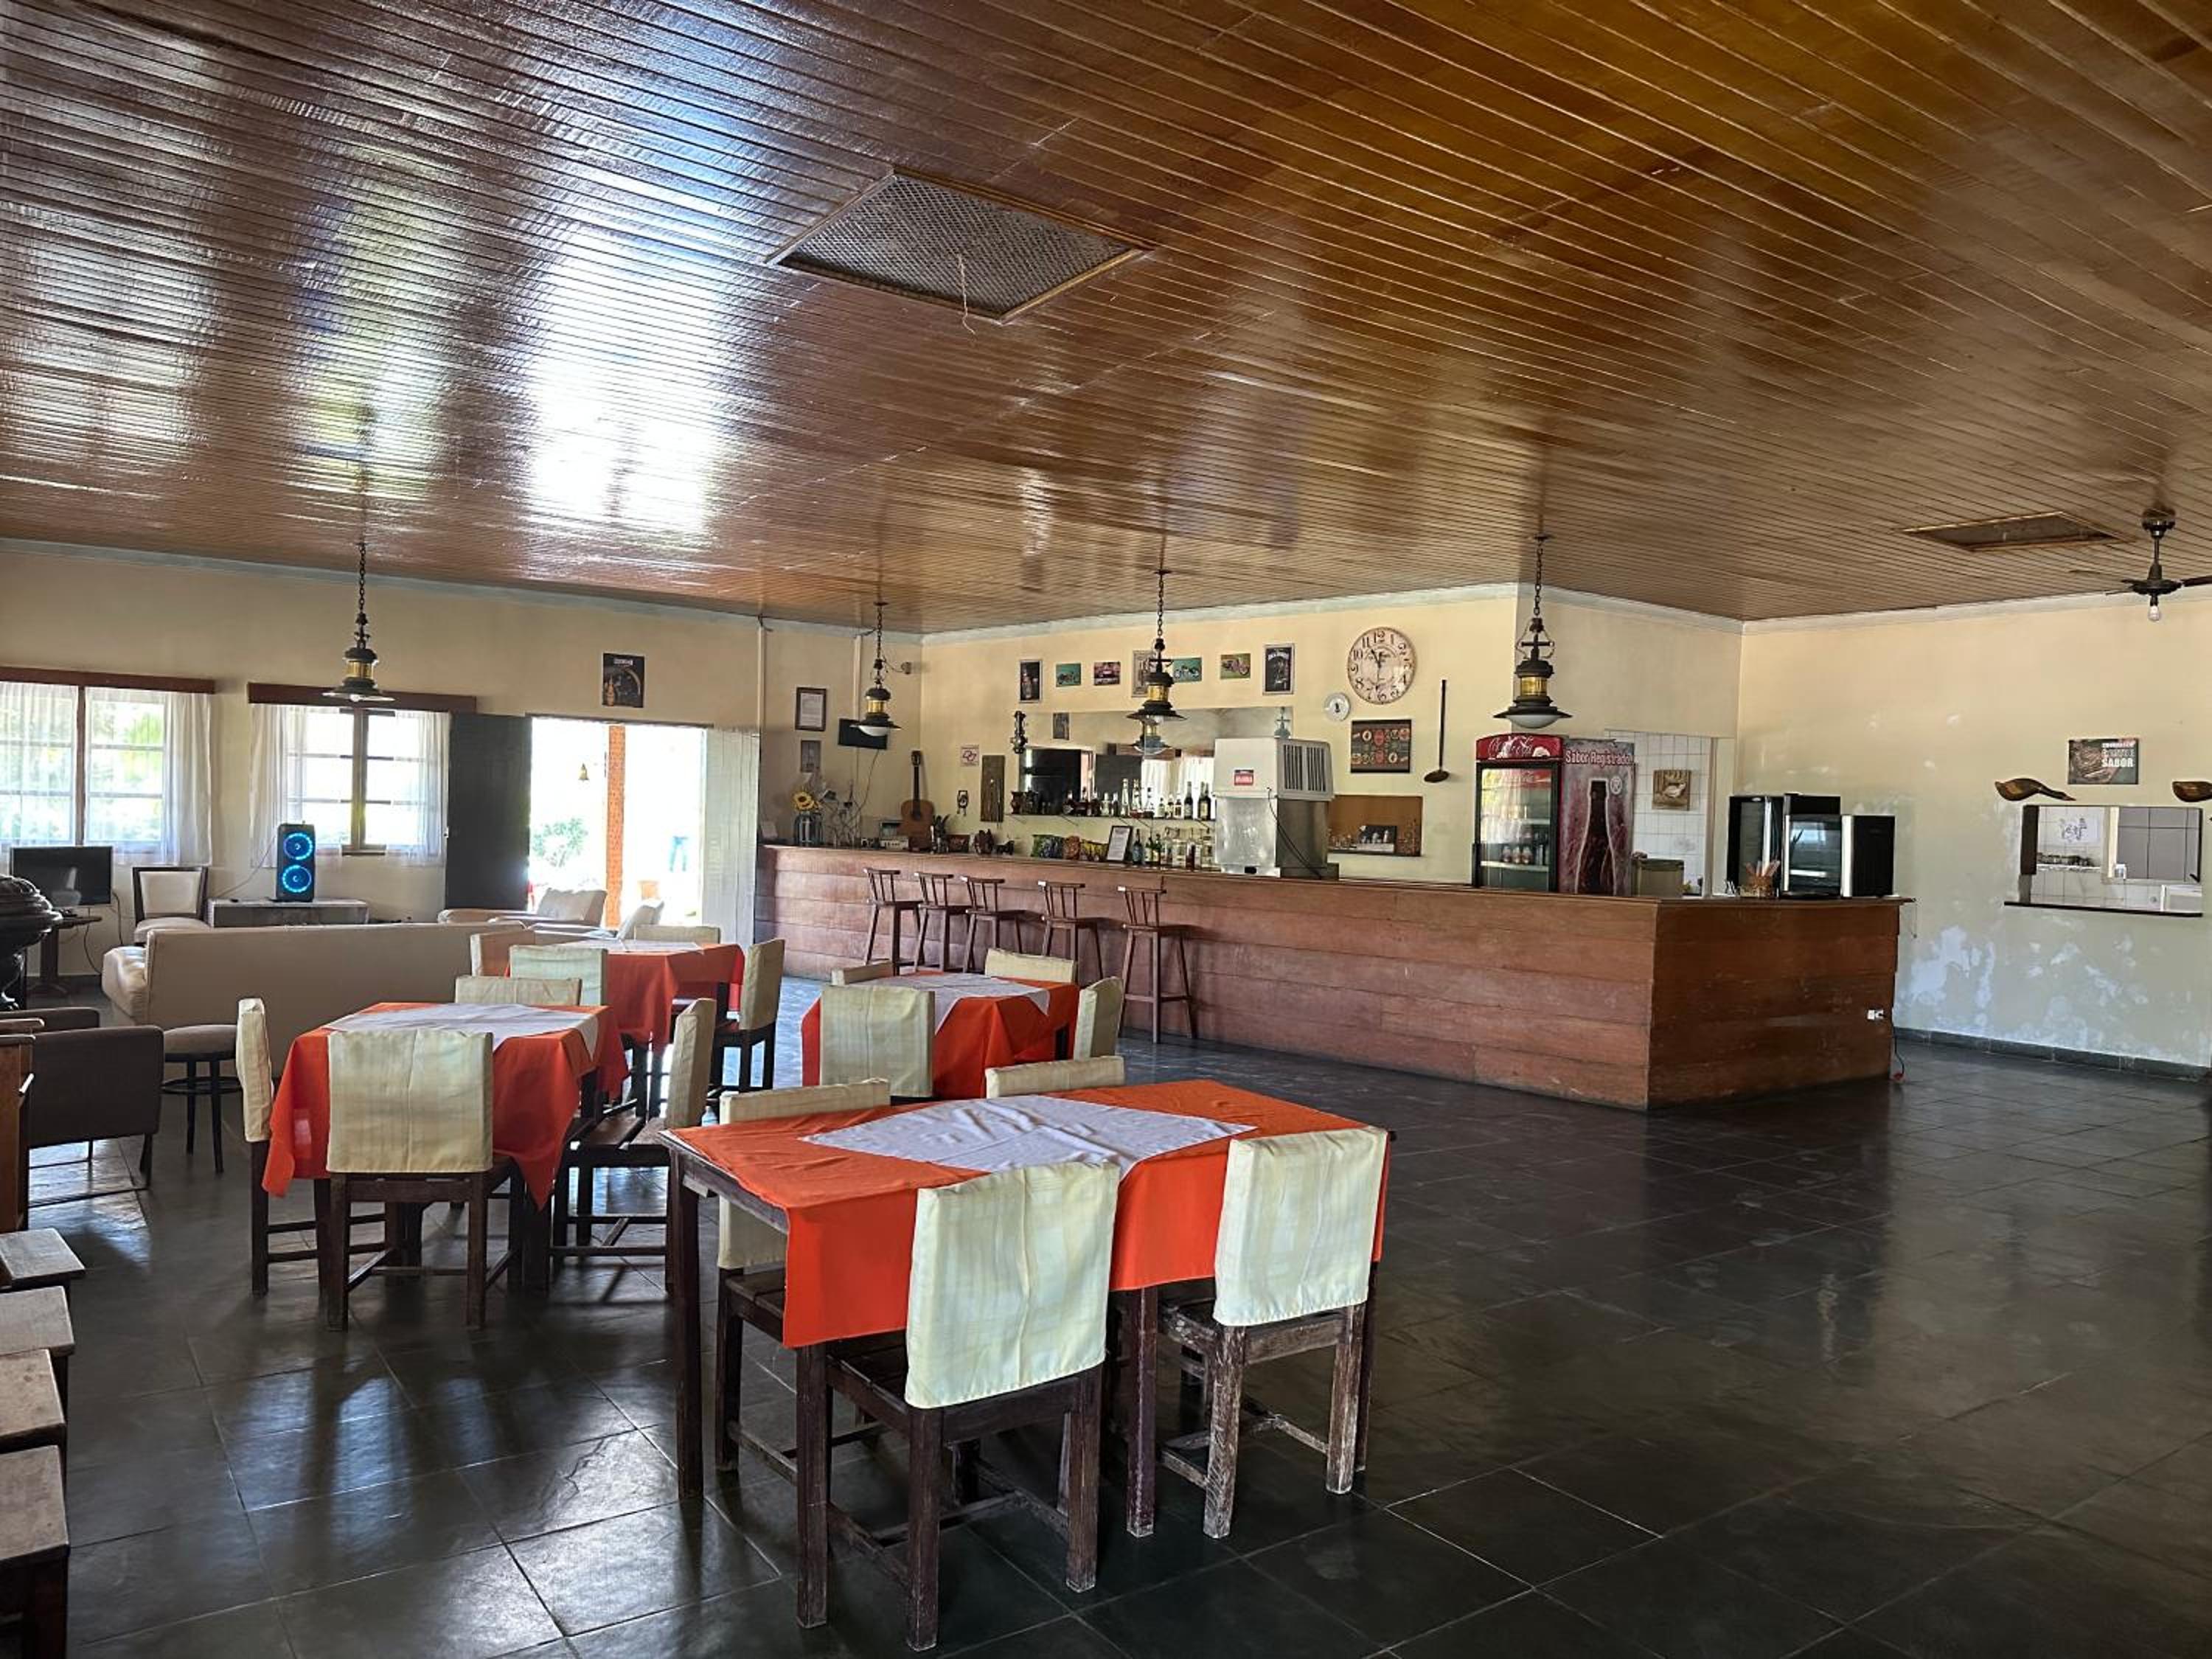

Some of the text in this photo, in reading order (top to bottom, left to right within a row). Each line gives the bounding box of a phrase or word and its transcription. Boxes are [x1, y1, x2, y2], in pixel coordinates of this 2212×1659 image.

[1362, 636, 1371, 649] 11
[1374, 631, 1385, 644] 12
[1565, 750, 1590, 764] Sabor
[2101, 757, 2134, 768] SABOR
